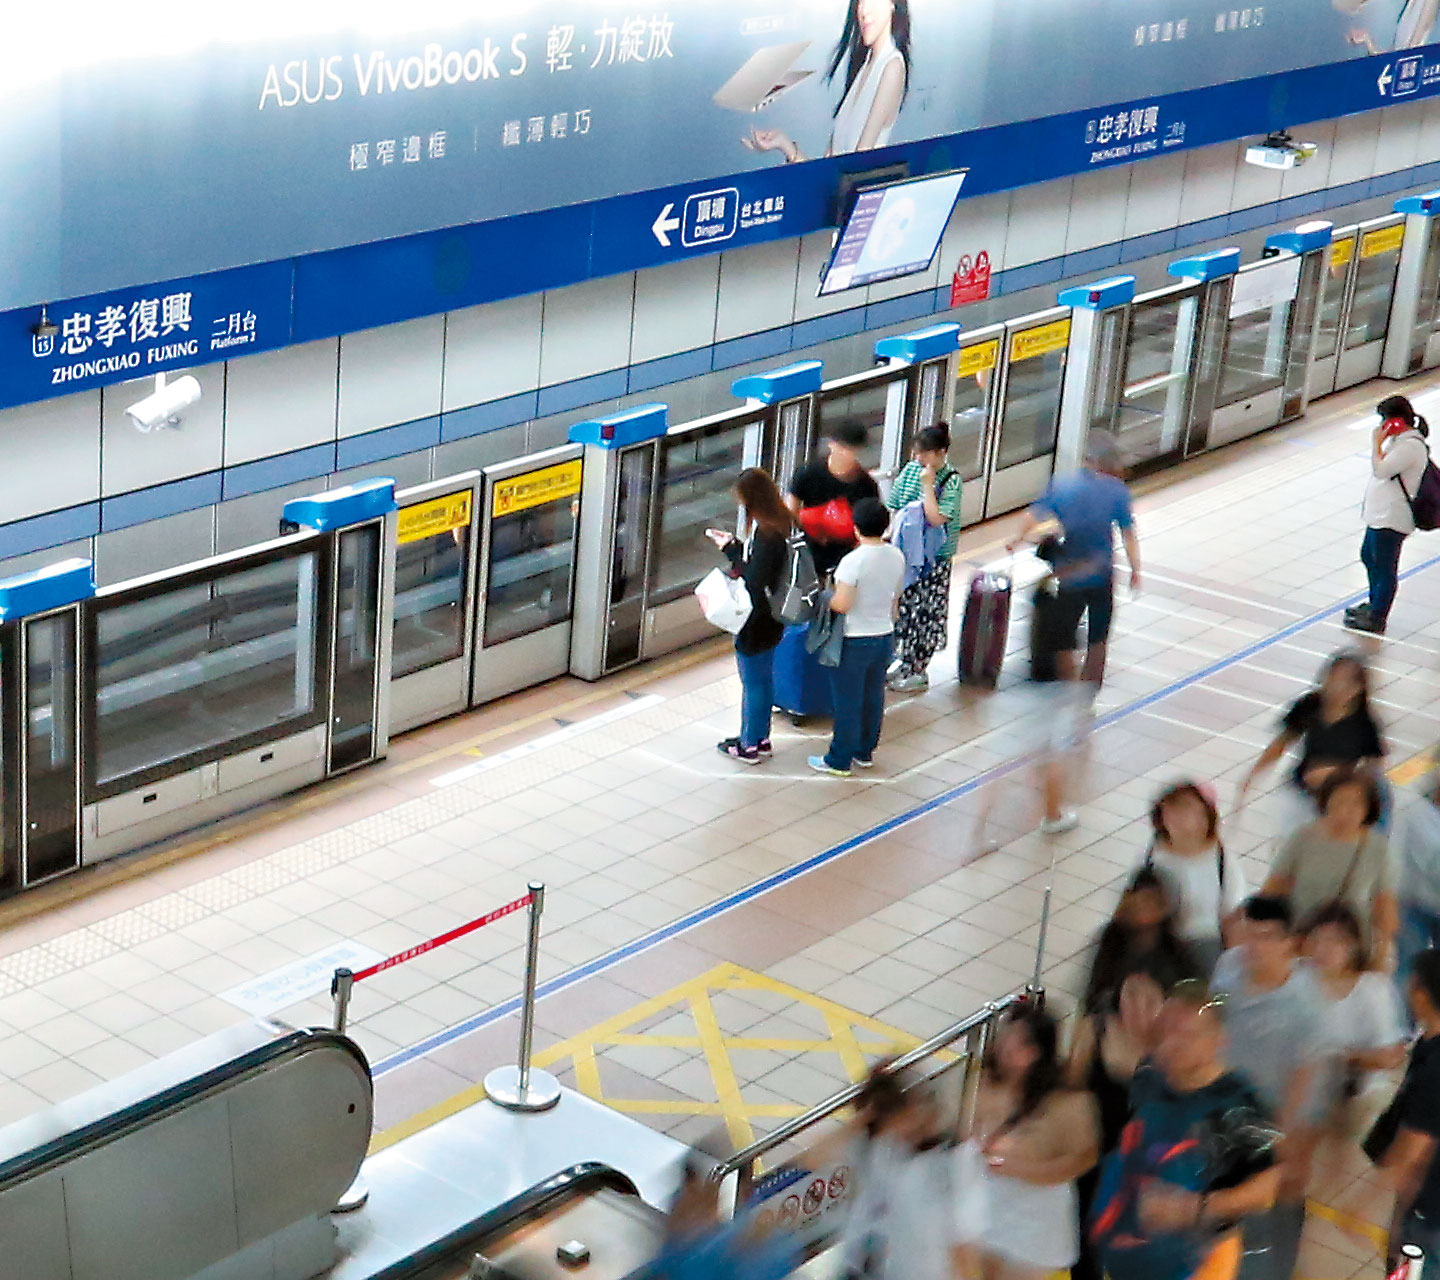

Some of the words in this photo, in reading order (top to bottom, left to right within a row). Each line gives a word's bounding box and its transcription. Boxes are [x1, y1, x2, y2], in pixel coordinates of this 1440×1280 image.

[258, 55, 343, 111] ASUS
[354, 37, 501, 98] VivoBook
[509, 32, 528, 77] S
[59, 292, 193, 355] 忠孝復興
[210, 335, 249, 351] Platform
[211, 310, 257, 337] 二月台
[51, 352, 141, 385] ZHONGXIAO
[147, 339, 199, 365] FUXING
